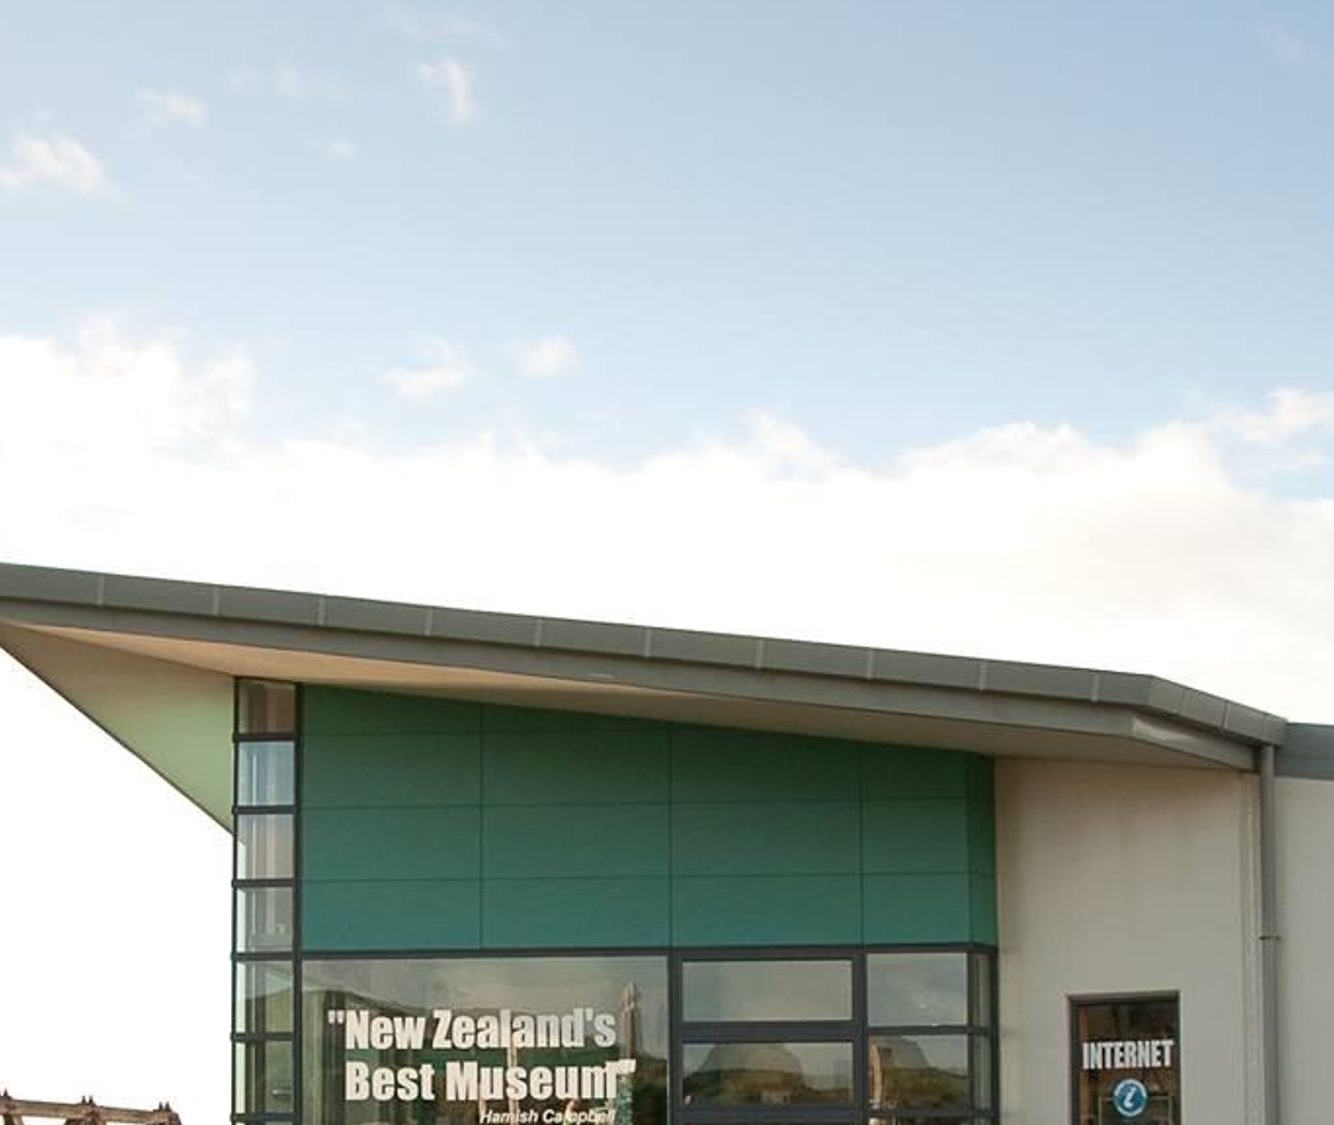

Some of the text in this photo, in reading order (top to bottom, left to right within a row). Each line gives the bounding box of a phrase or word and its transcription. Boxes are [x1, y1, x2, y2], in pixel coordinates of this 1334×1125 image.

[433, 1007, 617, 1049] Zealand's
[1082, 1039, 1174, 1070] INTERNET
[345, 1061, 436, 1101] Best
[479, 1109, 539, 1124] Hamish
